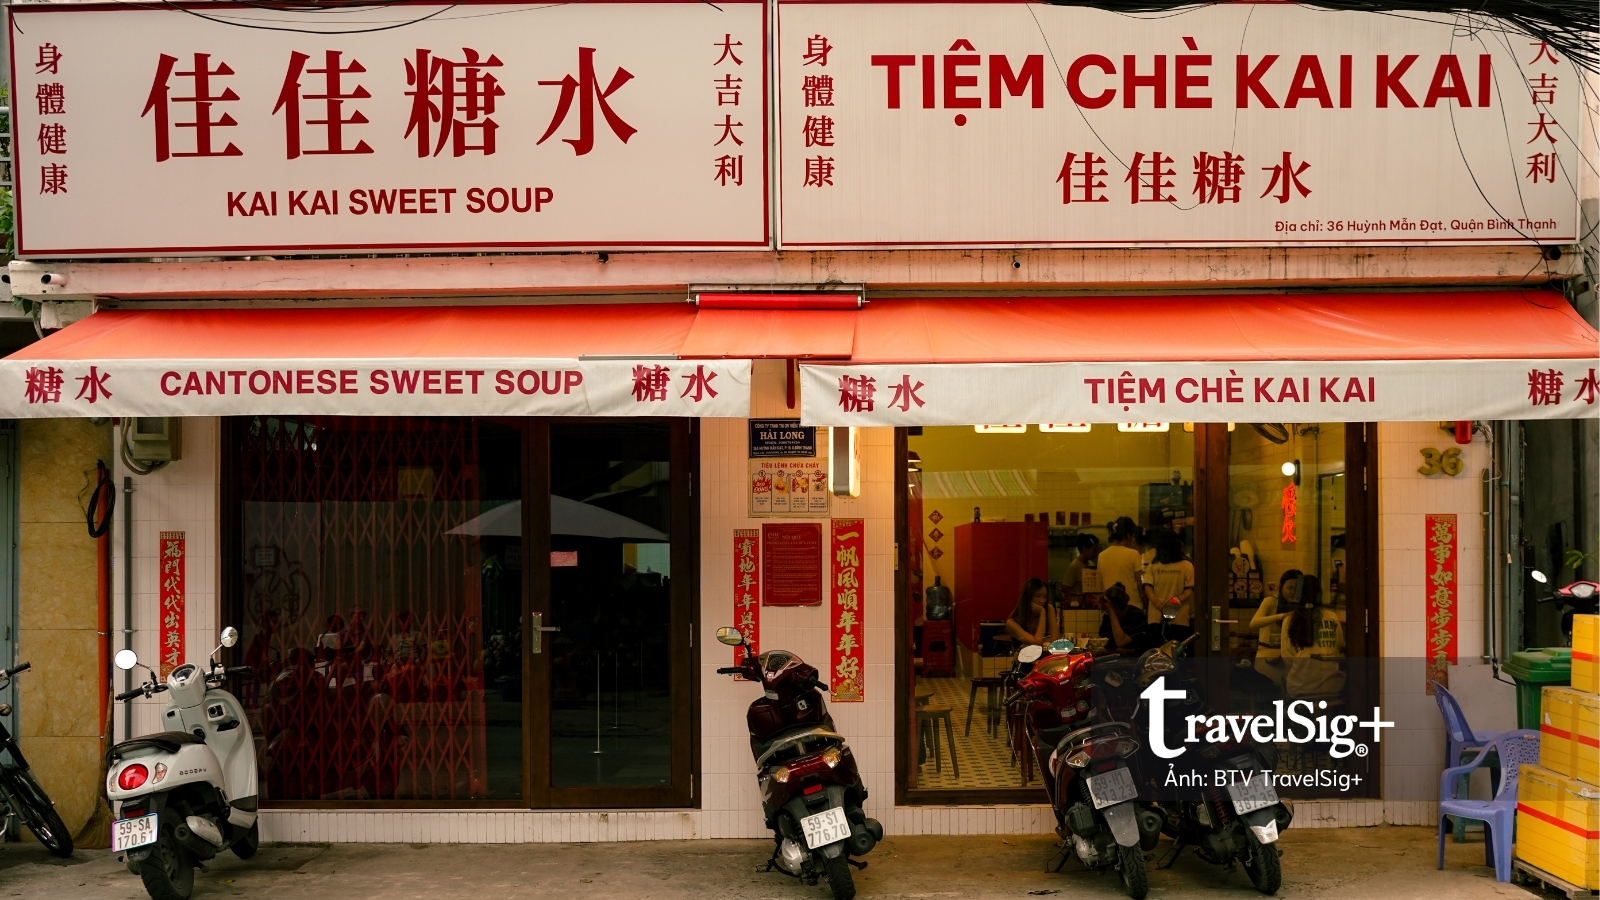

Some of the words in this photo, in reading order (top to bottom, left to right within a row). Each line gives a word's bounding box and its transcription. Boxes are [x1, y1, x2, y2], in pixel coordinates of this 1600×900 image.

[871, 39, 1043, 126] TIỆM
[1066, 37, 1212, 109] CHÈ
[1236, 54, 1353, 109] KAI
[1376, 54, 1492, 109] KAI
[36, 42, 68, 195] 身體健康
[141, 47, 638, 163] 佳佳糖水
[714, 33, 744, 187] 大吉大利
[801, 34, 835, 188] 身體健康
[1526, 40, 1559, 183] 大吉大利
[1056, 151, 1312, 205] 佳佳糖水
[228, 190, 277, 217] KAI
[289, 189, 339, 216] KAI
[348, 188, 457, 216] SWEET
[467, 187, 554, 214] SOUP
[1274, 220, 1297, 235] Địa
[1300, 218, 1323, 232] chỉ:
[1326, 220, 1344, 231] 36
[1347, 219, 1386, 233] Huỳnh
[1389, 216, 1417, 231] Mẫn
[1419, 219, 1447, 233] Đạt,
[1450, 219, 1484, 233] Quận
[1487, 218, 1514, 231] Bình
[1517, 218, 1557, 232] Thạnh
[24, 365, 112, 404] 糖水
[160, 369, 359, 397] CANTONESE
[369, 369, 485, 395] SWEET
[494, 368, 583, 395] SOUP
[631, 364, 719, 403] 糖水
[838, 374, 926, 413] 糖水
[1083, 371, 1165, 411] TIỆM
[1175, 370, 1244, 404] CHÈ
[1254, 377, 1310, 403] KAI
[1319, 377, 1375, 403] KAI
[760, 428, 777, 440] HẢI
[780, 431, 805, 440] LONG
[1417, 447, 1464, 477] 36
[835, 531, 860, 680] 一帆風順年年好
[1095, 784, 1135, 805] 513.23
[1236, 789, 1275, 812] 387.35
[117, 830, 153, 849] 170.61
[119, 817, 151, 836] 59-SA
[807, 811, 838, 831] 59-S1
[808, 823, 848, 847] 776.70
